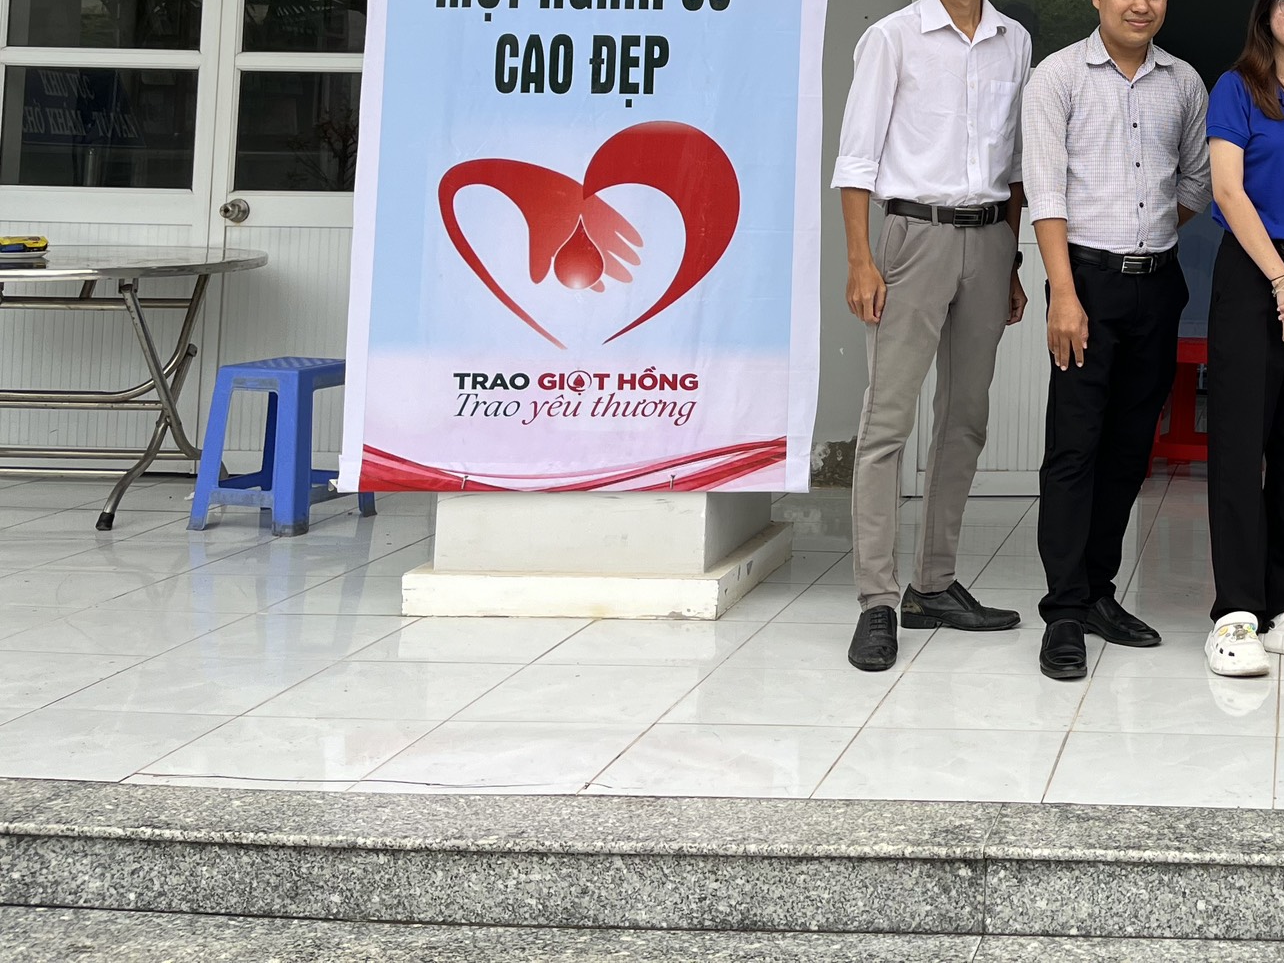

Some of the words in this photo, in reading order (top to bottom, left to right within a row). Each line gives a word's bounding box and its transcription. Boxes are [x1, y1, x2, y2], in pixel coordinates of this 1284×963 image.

[494, 33, 574, 94] CAO
[589, 34, 670, 108] ĐẸP
[453, 372, 530, 391] TRAO
[538, 370, 610, 395] GIỌT
[617, 366, 699, 391] HỒNG
[453, 393, 520, 417] Trao
[522, 394, 581, 425] yêu
[590, 392, 697, 426] thương
